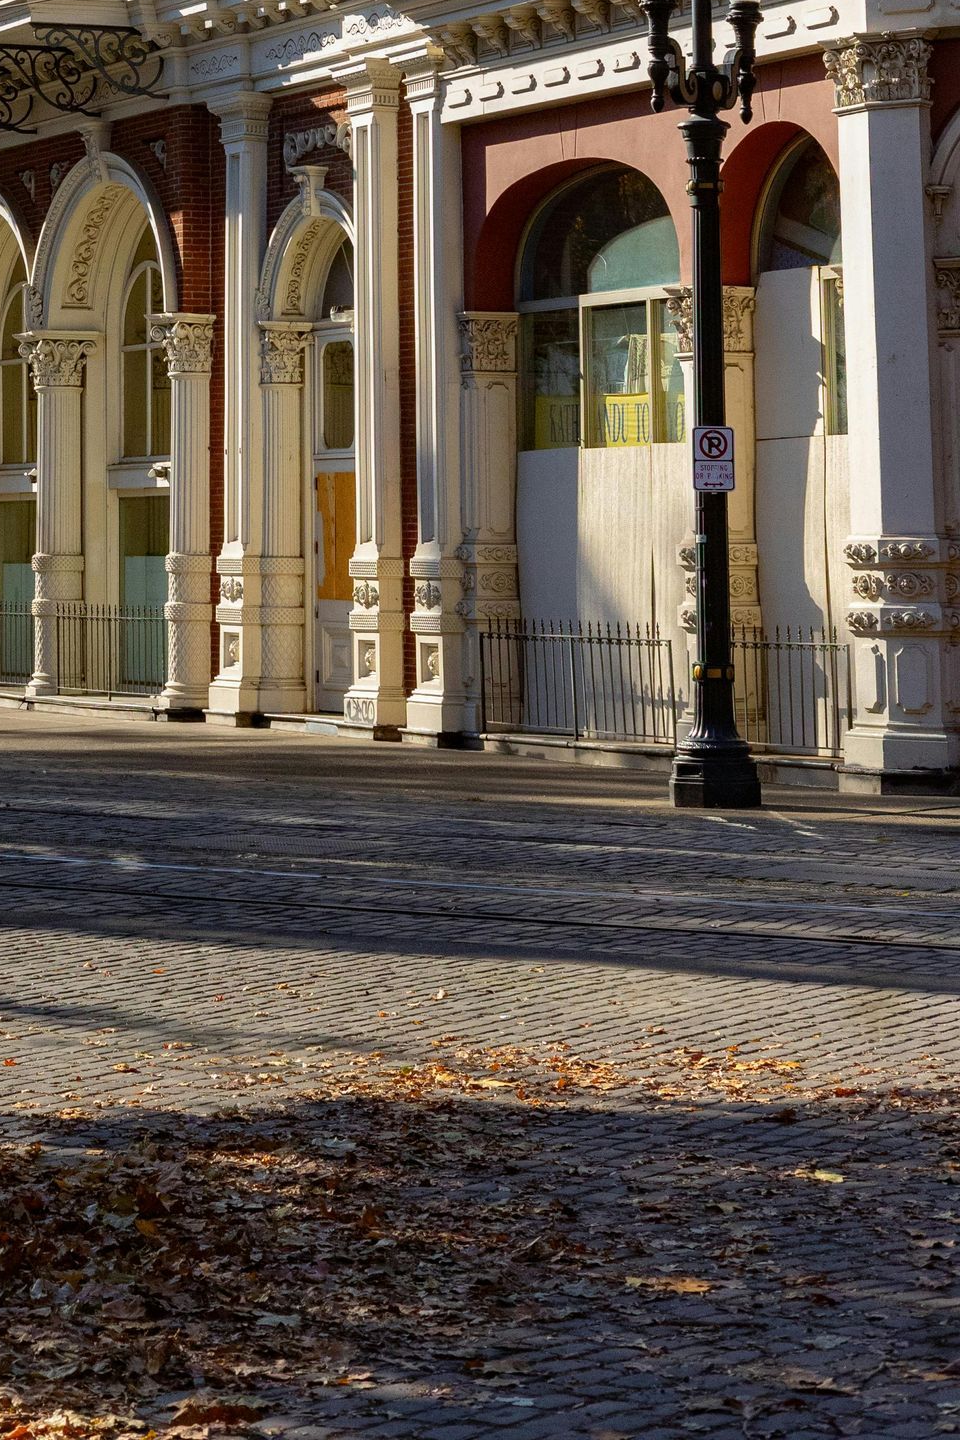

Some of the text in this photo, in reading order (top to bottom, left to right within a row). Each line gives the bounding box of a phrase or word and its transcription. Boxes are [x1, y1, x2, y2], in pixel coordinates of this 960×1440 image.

[550, 404, 628, 443] KATHANDU
[635, 403, 650, 443] TO
[707, 472, 733, 480] PKING
